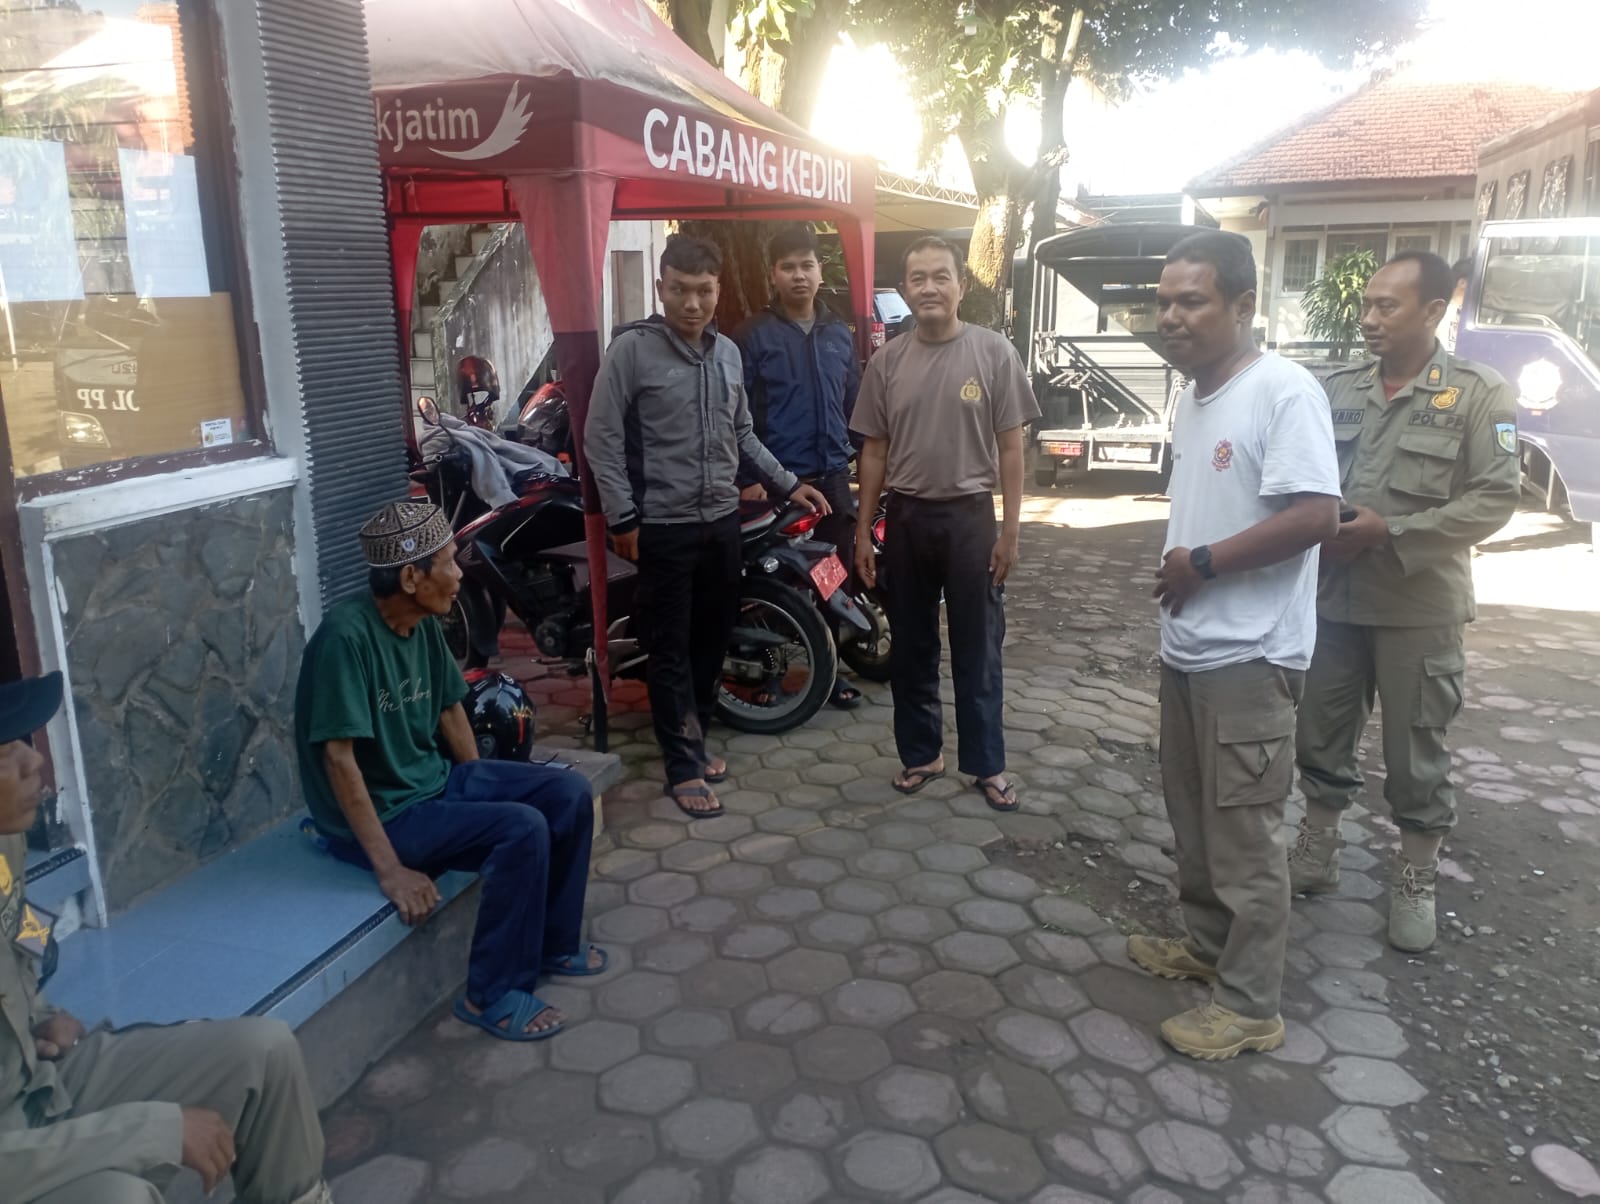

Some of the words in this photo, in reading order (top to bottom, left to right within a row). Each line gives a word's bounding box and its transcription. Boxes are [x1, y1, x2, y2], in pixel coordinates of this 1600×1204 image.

[643, 107, 777, 191] CABANG
[783, 145, 852, 204] KEDIRI
[1412, 412, 1437, 426] POL
[1445, 416, 1464, 430] PP
